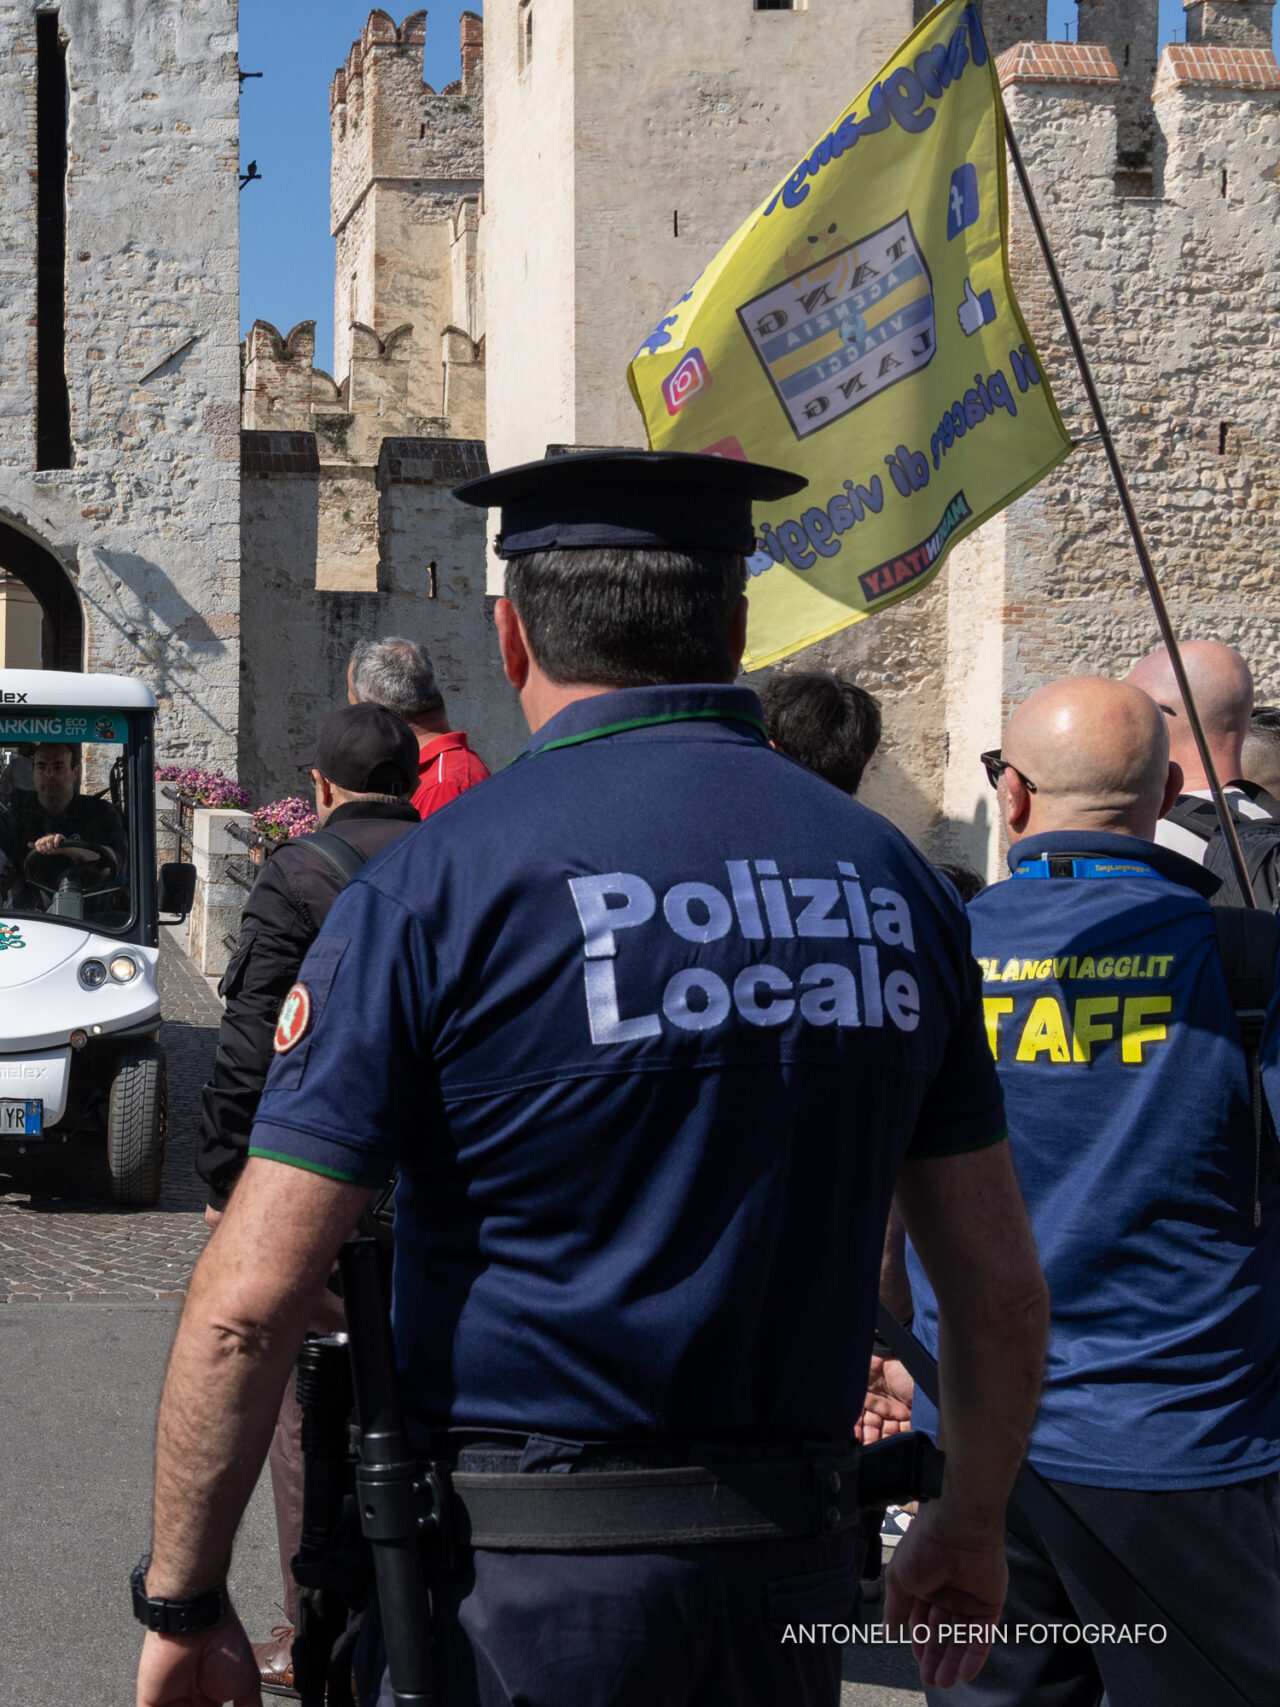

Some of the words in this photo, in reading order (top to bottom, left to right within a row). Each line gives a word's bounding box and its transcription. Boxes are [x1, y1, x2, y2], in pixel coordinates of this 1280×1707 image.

[65, 718, 87, 727] ECO
[65, 726, 88, 736] CITY
[568, 859, 916, 958] Polizia
[583, 944, 920, 1045] Locale
[982, 996, 1172, 1063] TAFF
